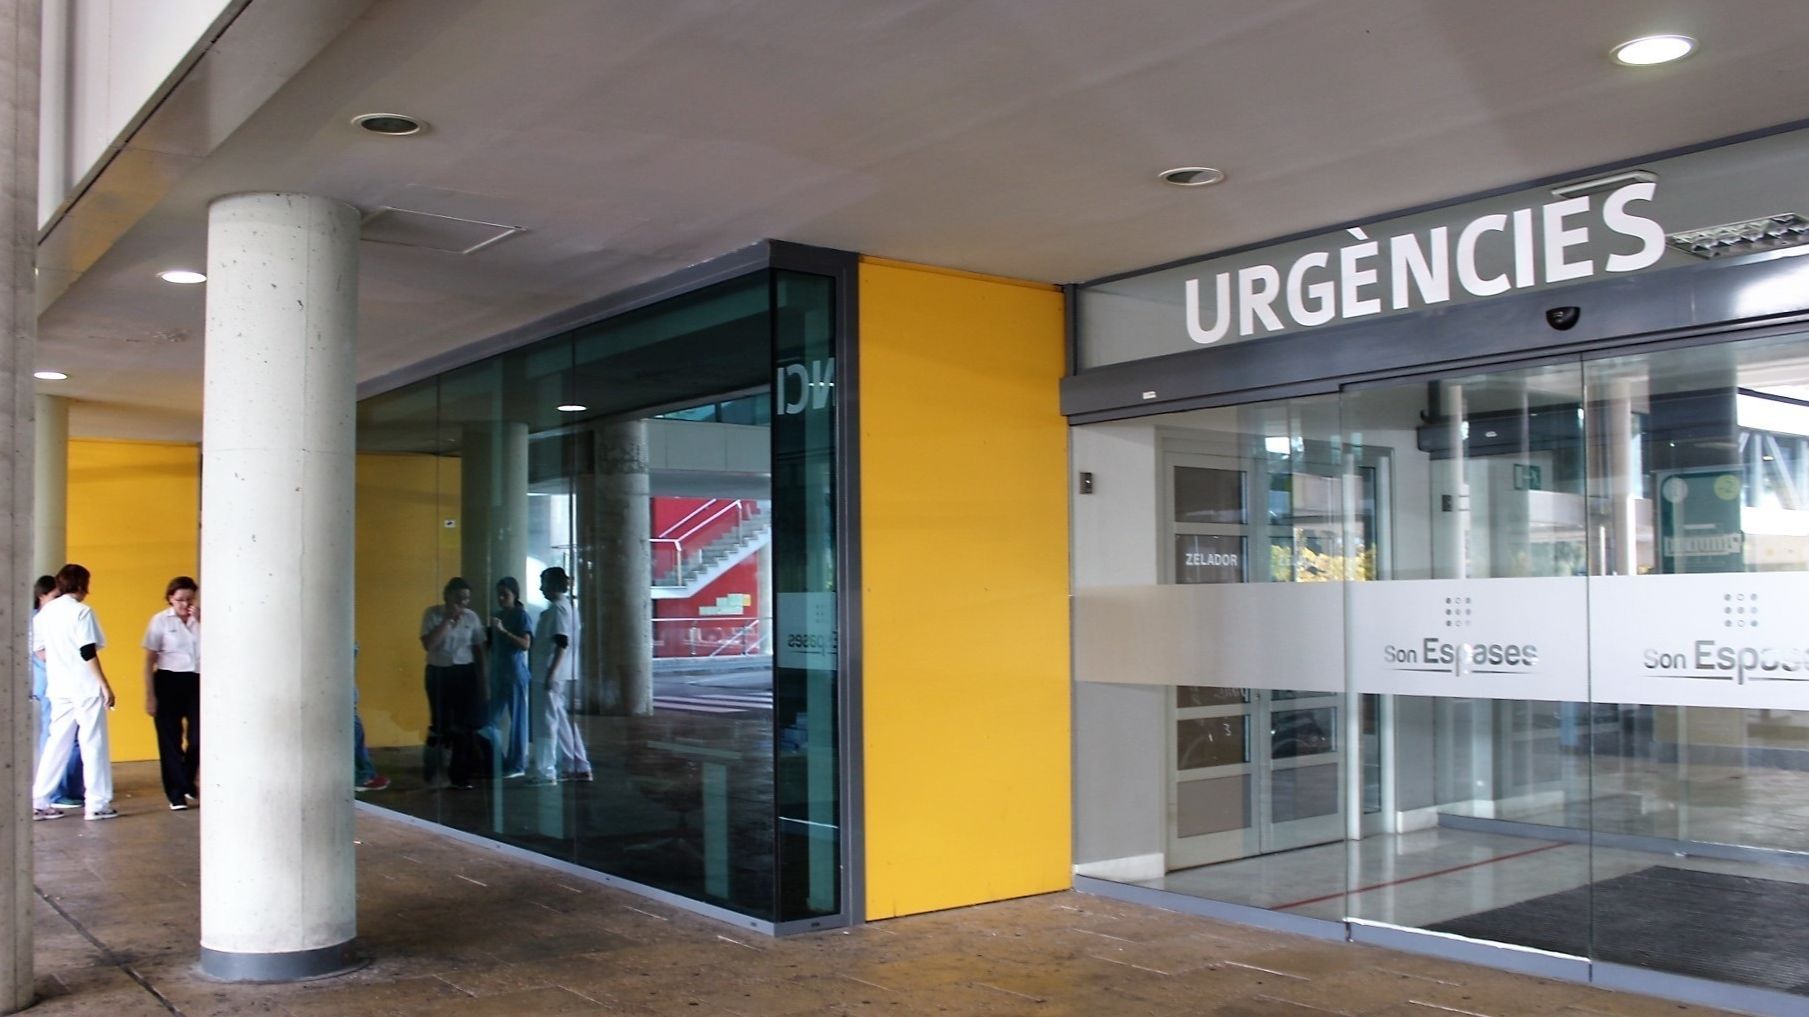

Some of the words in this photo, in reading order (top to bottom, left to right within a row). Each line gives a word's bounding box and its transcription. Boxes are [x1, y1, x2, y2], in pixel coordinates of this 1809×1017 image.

[1184, 182, 1667, 344] URGÈNCIES
[1185, 553, 1238, 566] ZELADOR
[1384, 645, 1417, 663] Son
[1644, 649, 1686, 669] Son
